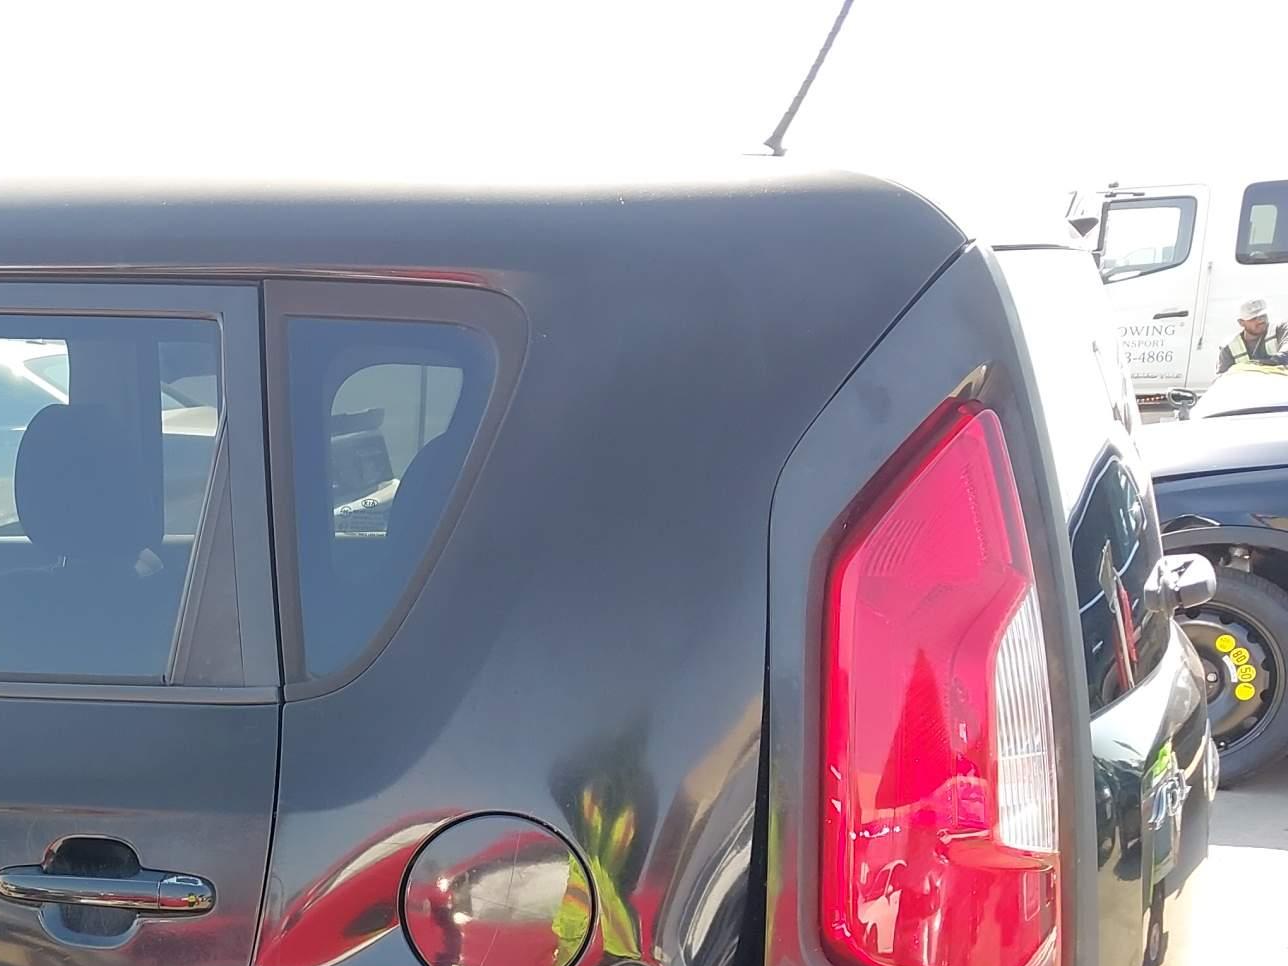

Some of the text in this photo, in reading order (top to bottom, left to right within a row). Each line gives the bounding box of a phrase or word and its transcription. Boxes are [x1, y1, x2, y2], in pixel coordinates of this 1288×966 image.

[1125, 350, 1174, 363] 3-4866
[1232, 650, 1247, 663] 80
[1240, 667, 1253, 679] 50
